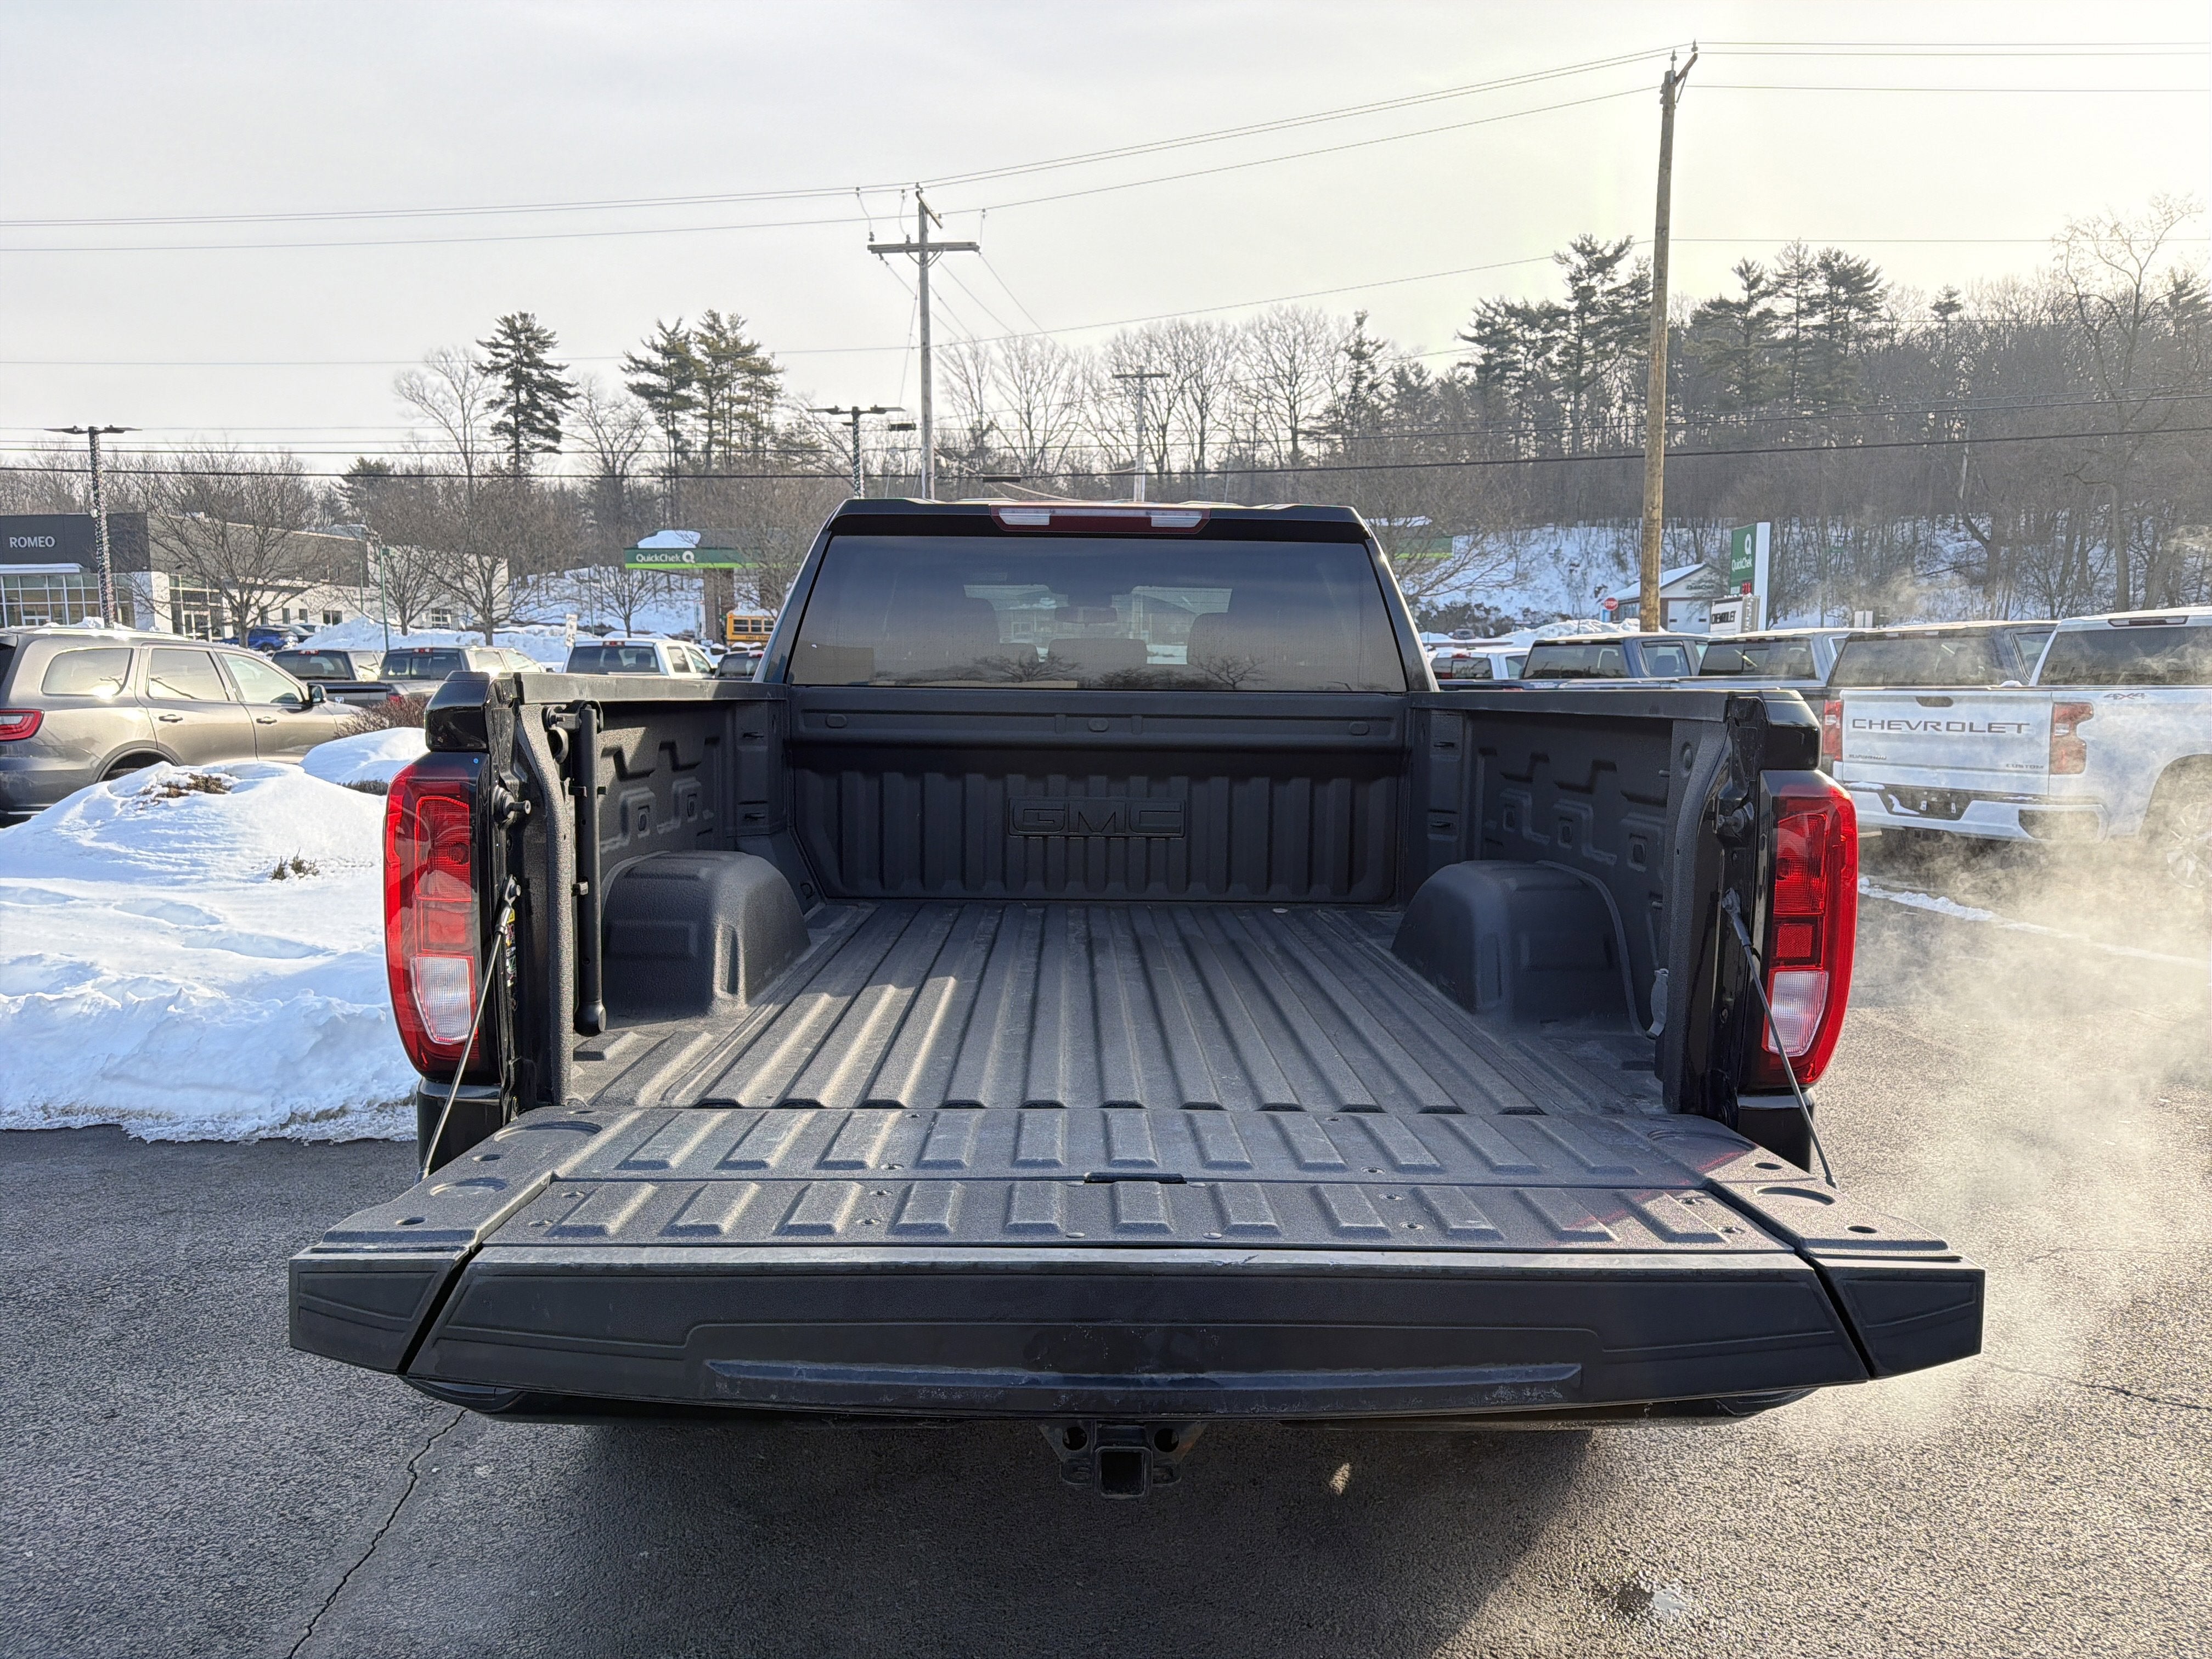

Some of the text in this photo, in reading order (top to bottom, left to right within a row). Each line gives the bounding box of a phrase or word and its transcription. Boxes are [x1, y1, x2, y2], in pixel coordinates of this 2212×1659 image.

[9, 535, 55, 548] ROMEO
[636, 553, 681, 563] QuickChek
[1731, 556, 1752, 572] QuickChek
[1852, 719, 2030, 734] CHEVROLET
[1013, 800, 1181, 834] GMC
